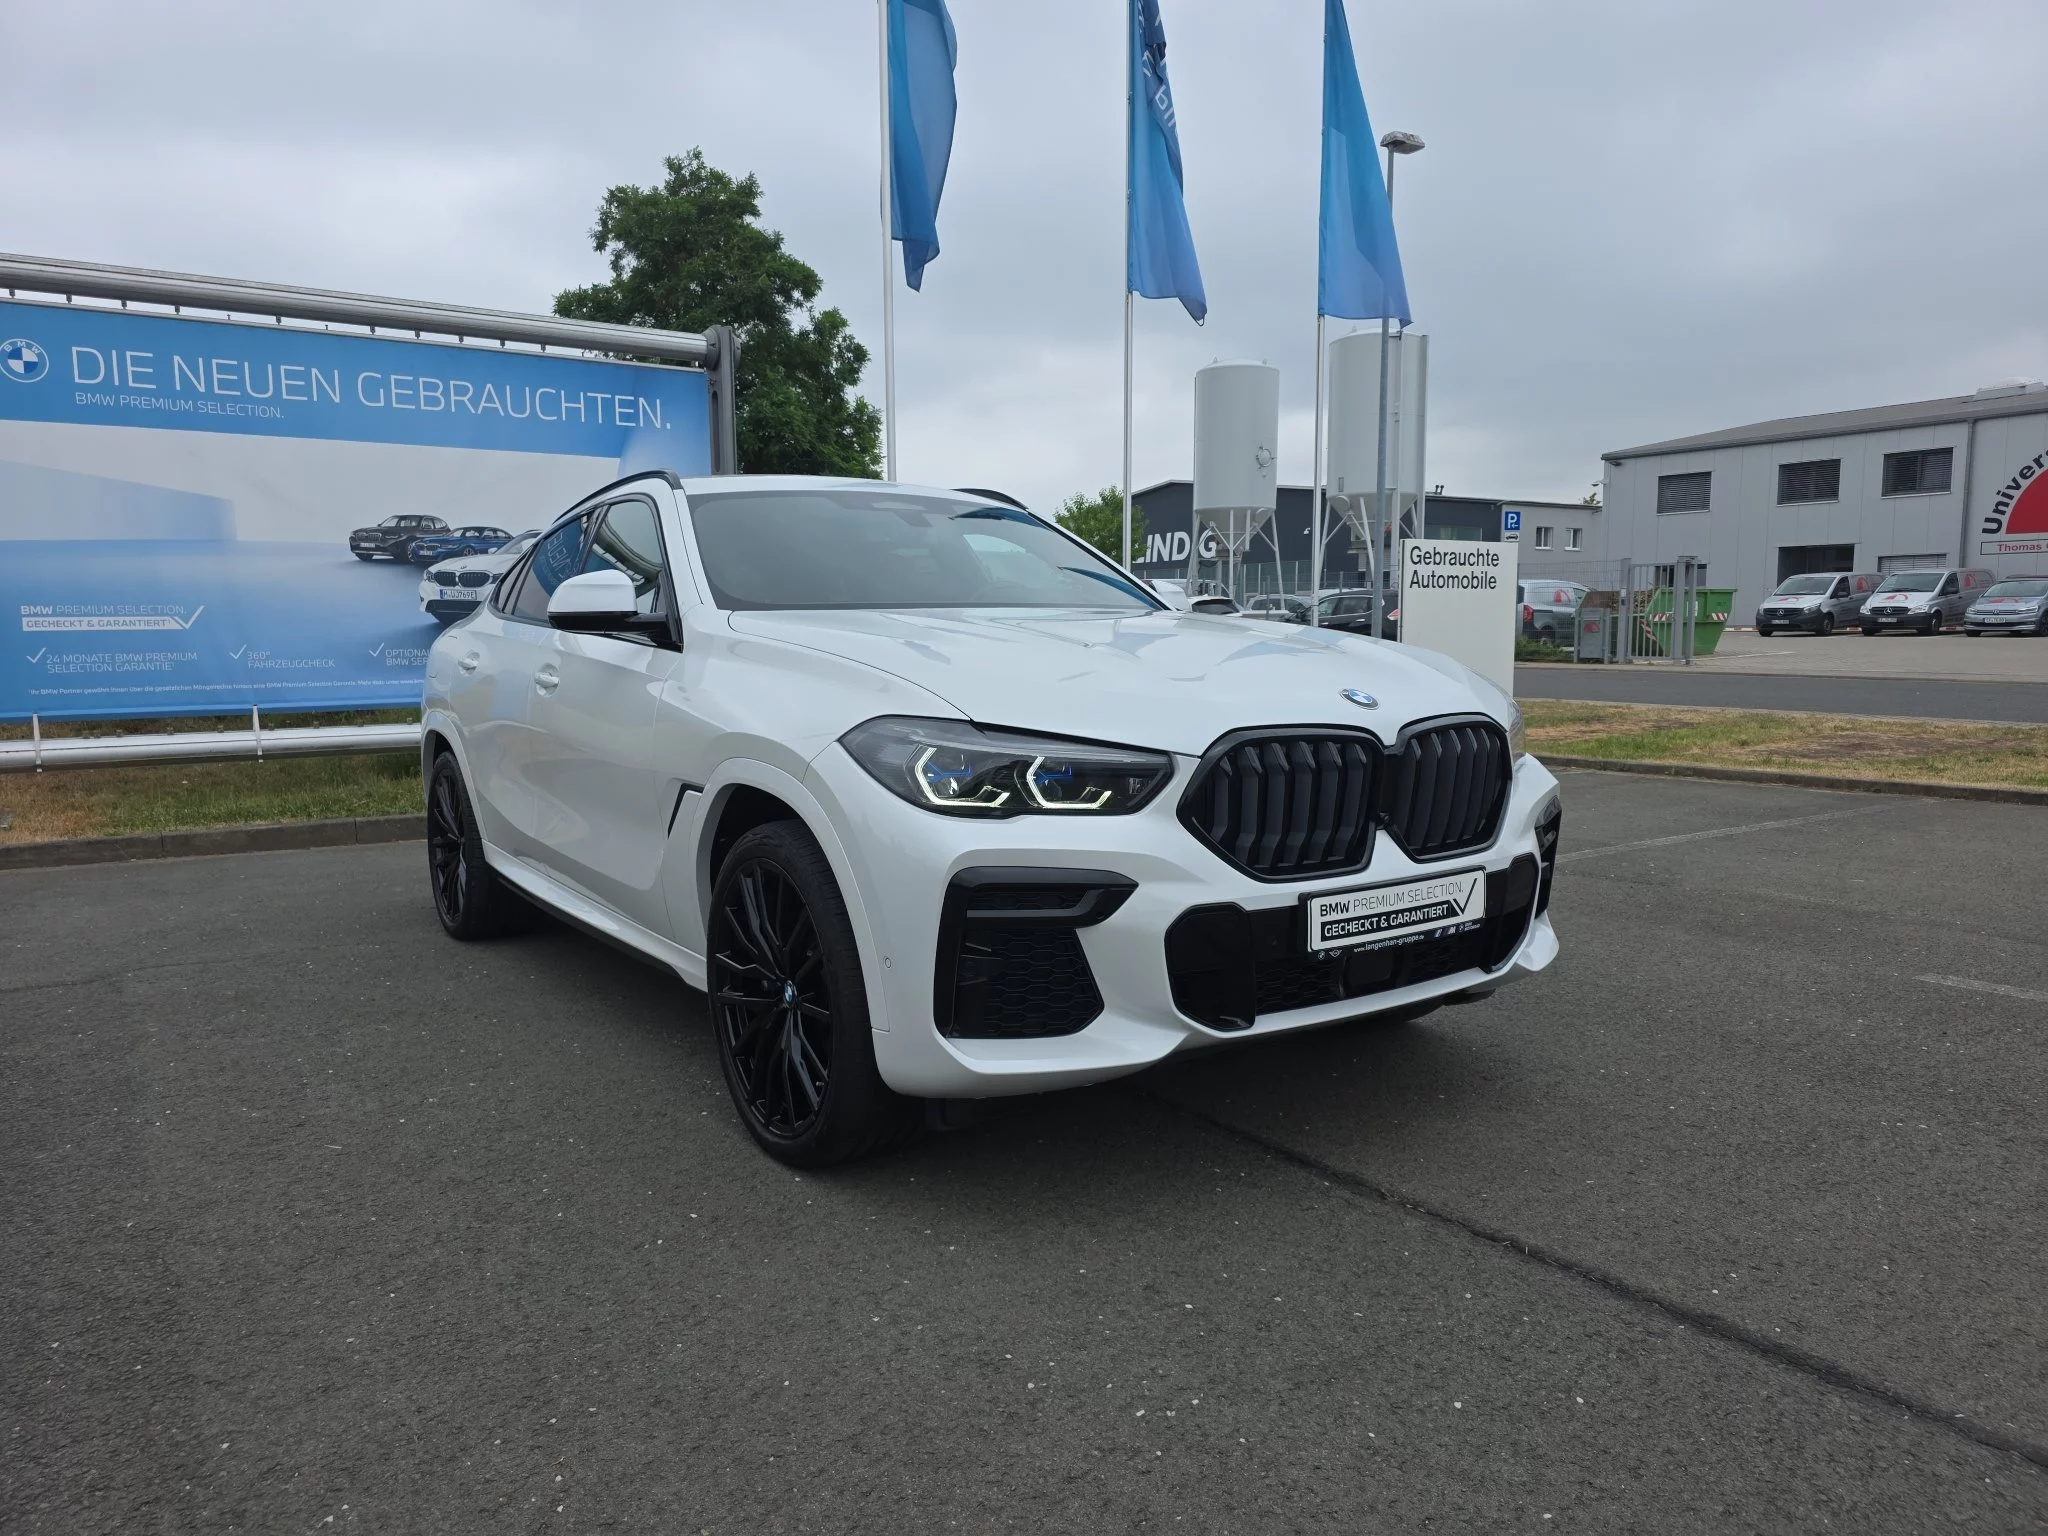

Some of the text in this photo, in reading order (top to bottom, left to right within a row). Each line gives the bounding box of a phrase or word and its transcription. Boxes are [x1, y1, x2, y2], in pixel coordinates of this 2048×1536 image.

[71, 346, 671, 430] DIE NEUEN GEBRAUCHTEN.
[75, 392, 285, 419] BMW PREMIUM SELECTION.
[1981, 450, 2048, 535] Univer
[1508, 513, 1518, 529] P
[1132, 528, 1217, 564] INDG
[1997, 544, 2042, 552] Thomas
[1410, 545, 1499, 567] Gebrauchte
[1409, 569, 1497, 590] Automobile
[20, 605, 187, 615] BMW PREMIUM SELECTION.
[26, 619, 84, 629] GECHECKT
[87, 619, 95, 628] &
[46, 651, 198, 664] 24 MONATE BMW PREMIUM
[248, 659, 336, 669] FAHRZEUGCHECK
[386, 657, 409, 666] BMW
[48, 663, 113, 674] SELECTION
[1320, 881, 1464, 917] BMW PREMIUM SELECTION.
[1324, 904, 1448, 937] GECHECKT & GARANTIERT
